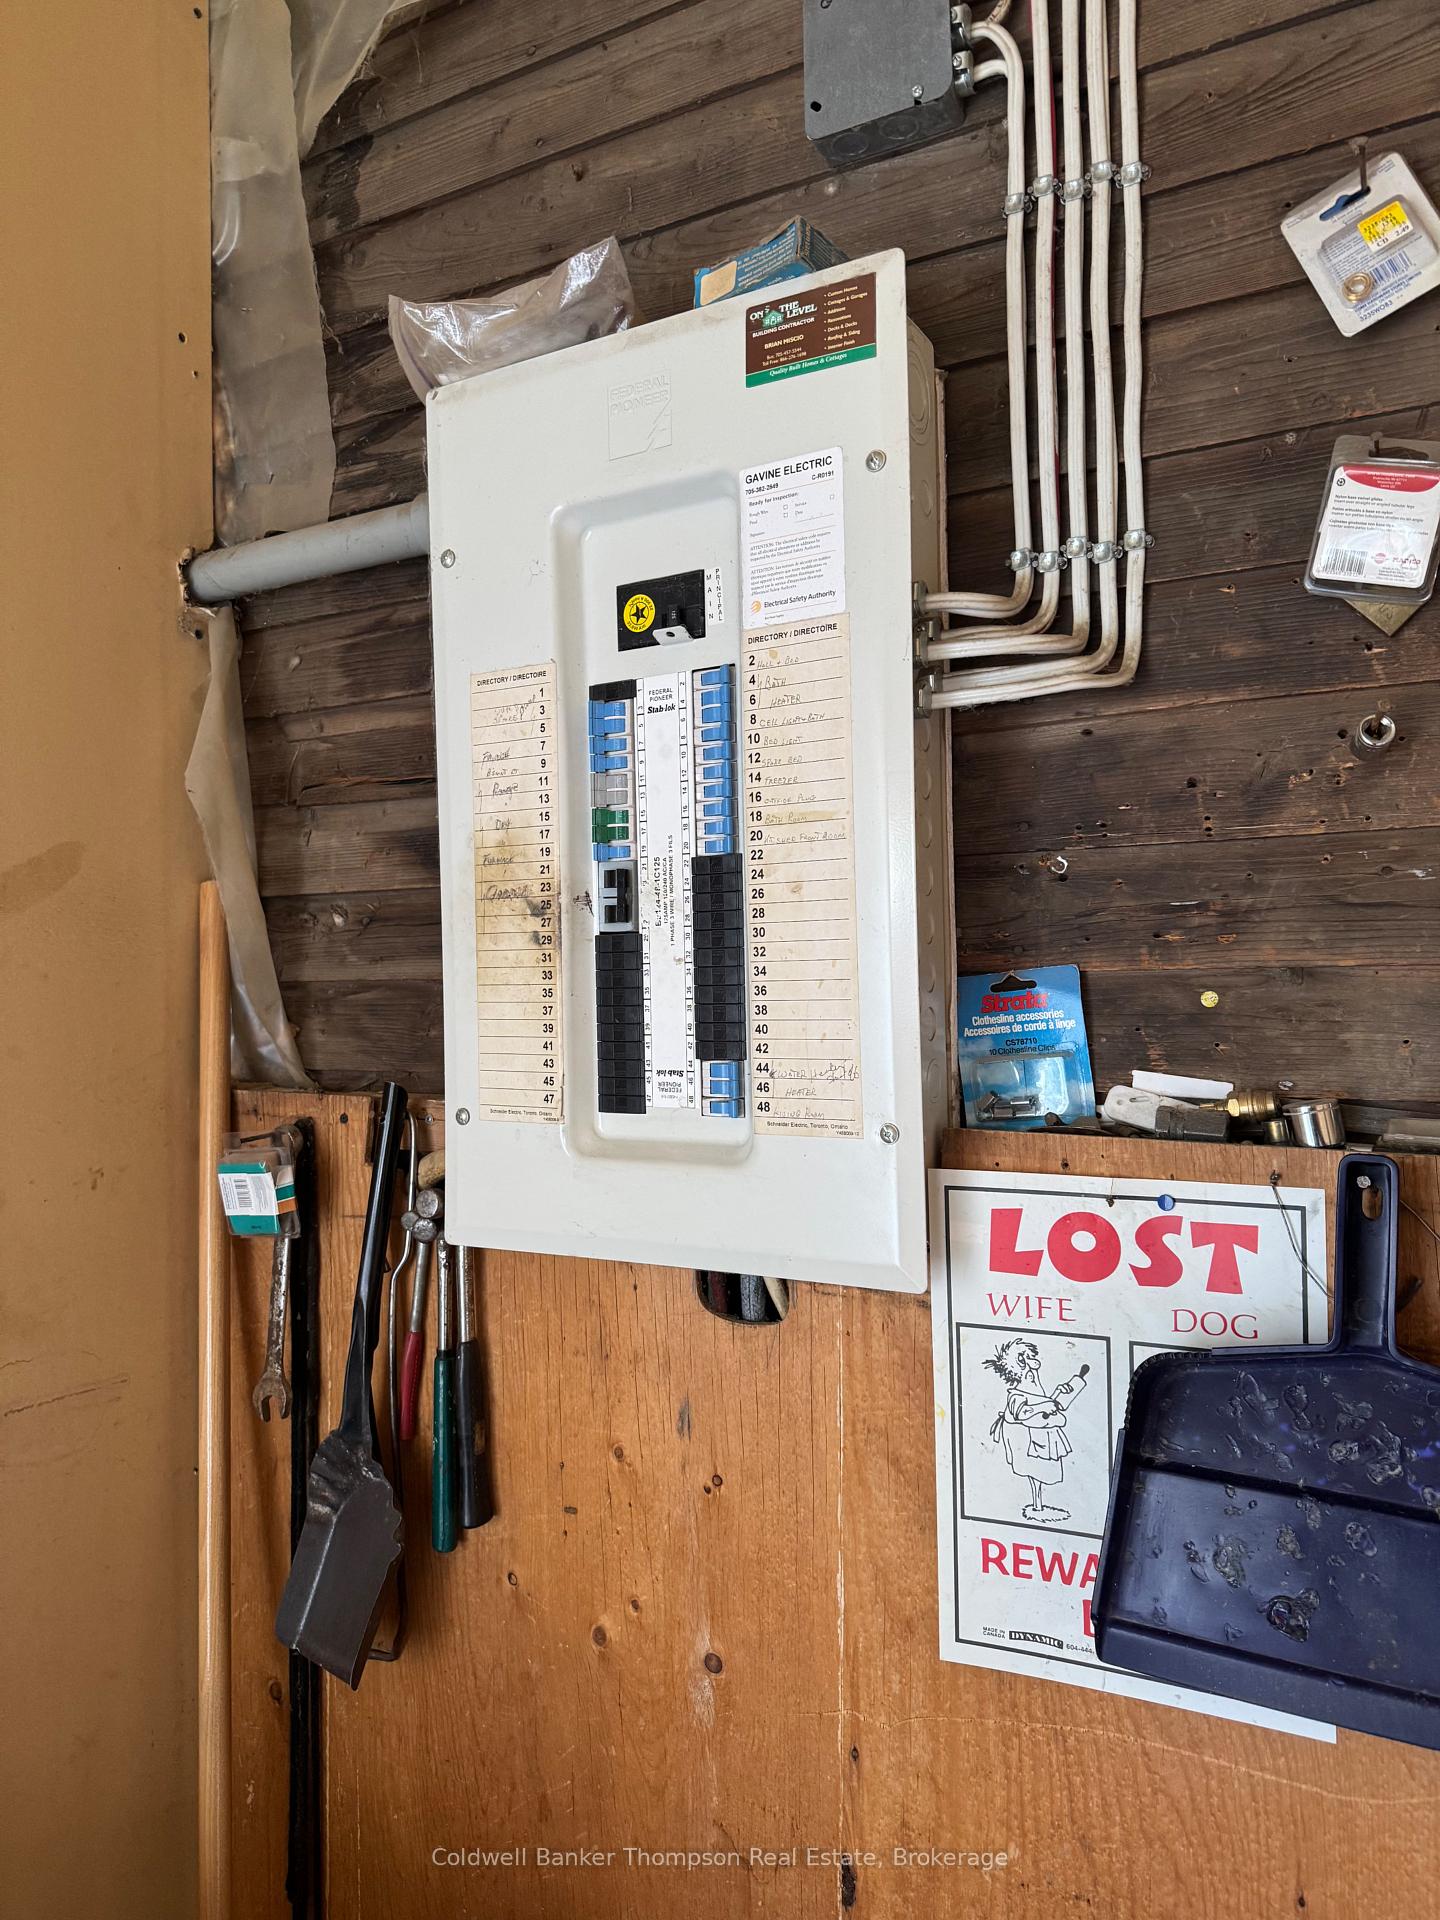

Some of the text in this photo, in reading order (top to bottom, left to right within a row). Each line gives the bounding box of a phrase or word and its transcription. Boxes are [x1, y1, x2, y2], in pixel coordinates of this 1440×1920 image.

[1395, 225, 1410, 237] 2.49
[750, 300, 799, 321] ON THE
[787, 303, 817, 317] LEVEL
[752, 317, 815, 338] BUILDING CONTRACTOR
[764, 335, 804, 349] BRIAN MISCIO
[769, 366, 788, 377] Quality
[801, 359, 819, 369] Homes
[825, 352, 847, 364] Cottages
[745, 455, 833, 485] GAVINE ELECTRIC
[811, 470, 834, 481] C-R0191
[749, 498, 763, 507] Ready
[764, 589, 836, 609] Electrical Safety Authority
[748, 631, 789, 645] DIRECTORY
[793, 623, 838, 637] DIRECTOIRE
[749, 655, 755, 666] 2
[477, 676, 509, 687] DIRECTORY
[512, 670, 547, 681] DIRECTOIRE
[749, 675, 755, 685] 4
[540, 688, 543, 697] 1
[648, 687, 673, 696] FEDERAL
[649, 693, 673, 702] PIONEER
[750, 695, 756, 705] 6
[540, 705, 545, 714] 3
[751, 714, 756, 724] 8
[540, 723, 545, 732] 5
[748, 733, 760, 744] 10
[541, 741, 545, 750] 7
[749, 753, 760, 763] 12
[541, 759, 546, 768] 9
[539, 776, 548, 785] 11
[749, 772, 761, 782] 14
[539, 794, 549, 803] 13
[750, 792, 761, 802] 16
[540, 812, 549, 821] 15
[750, 811, 762, 821] 18
[540, 830, 549, 839] 17
[751, 830, 762, 841] 20
[540, 847, 550, 856] 19
[751, 850, 763, 860] 22
[540, 865, 549, 874] 21
[752, 869, 764, 879] 24
[541, 882, 551, 892] 23
[752, 888, 764, 899] 26
[541, 900, 552, 910] 25
[752, 908, 764, 918] 28
[541, 916, 551, 927] 27
[753, 927, 765, 937] 30
[541, 936, 553, 945] 29
[754, 947, 766, 957] 32
[542, 953, 551, 962] 31
[542, 971, 552, 980] 33
[754, 966, 766, 976] 34
[543, 988, 553, 997] 35
[755, 985, 767, 996] 36
[980, 990, 1048, 1013] Strata
[543, 1006, 553, 1015] 37
[755, 1005, 767, 1015] 38
[972, 1009, 1064, 1027] Clothesline accessories
[543, 1024, 553, 1033] 39
[755, 1024, 768, 1034] 40
[964, 1018, 1076, 1037] Accessoires de corde à linge
[543, 1041, 552, 1050] 41
[1005, 1037, 1038, 1047] CS78710
[756, 1043, 768, 1053] 42
[997, 1045, 1037, 1055] Clothesline
[1038, 1044, 1056, 1052] Clips
[543, 1059, 554, 1068] 43
[756, 1063, 769, 1073] 44
[544, 1077, 554, 1086] 45
[757, 1082, 769, 1092] 46
[544, 1094, 554, 1103] 47
[757, 1102, 770, 1112] 48
[989, 1207, 1259, 1295] LOST
[985, 1291, 1259, 1341] WIFE DOG
[981, 1538, 1099, 1588] REWA
[983, 1630, 1006, 1639] CANADA
[1010, 1631, 1062, 1648] DYNAMIC
[1066, 1643, 1094, 1654] 604-444
